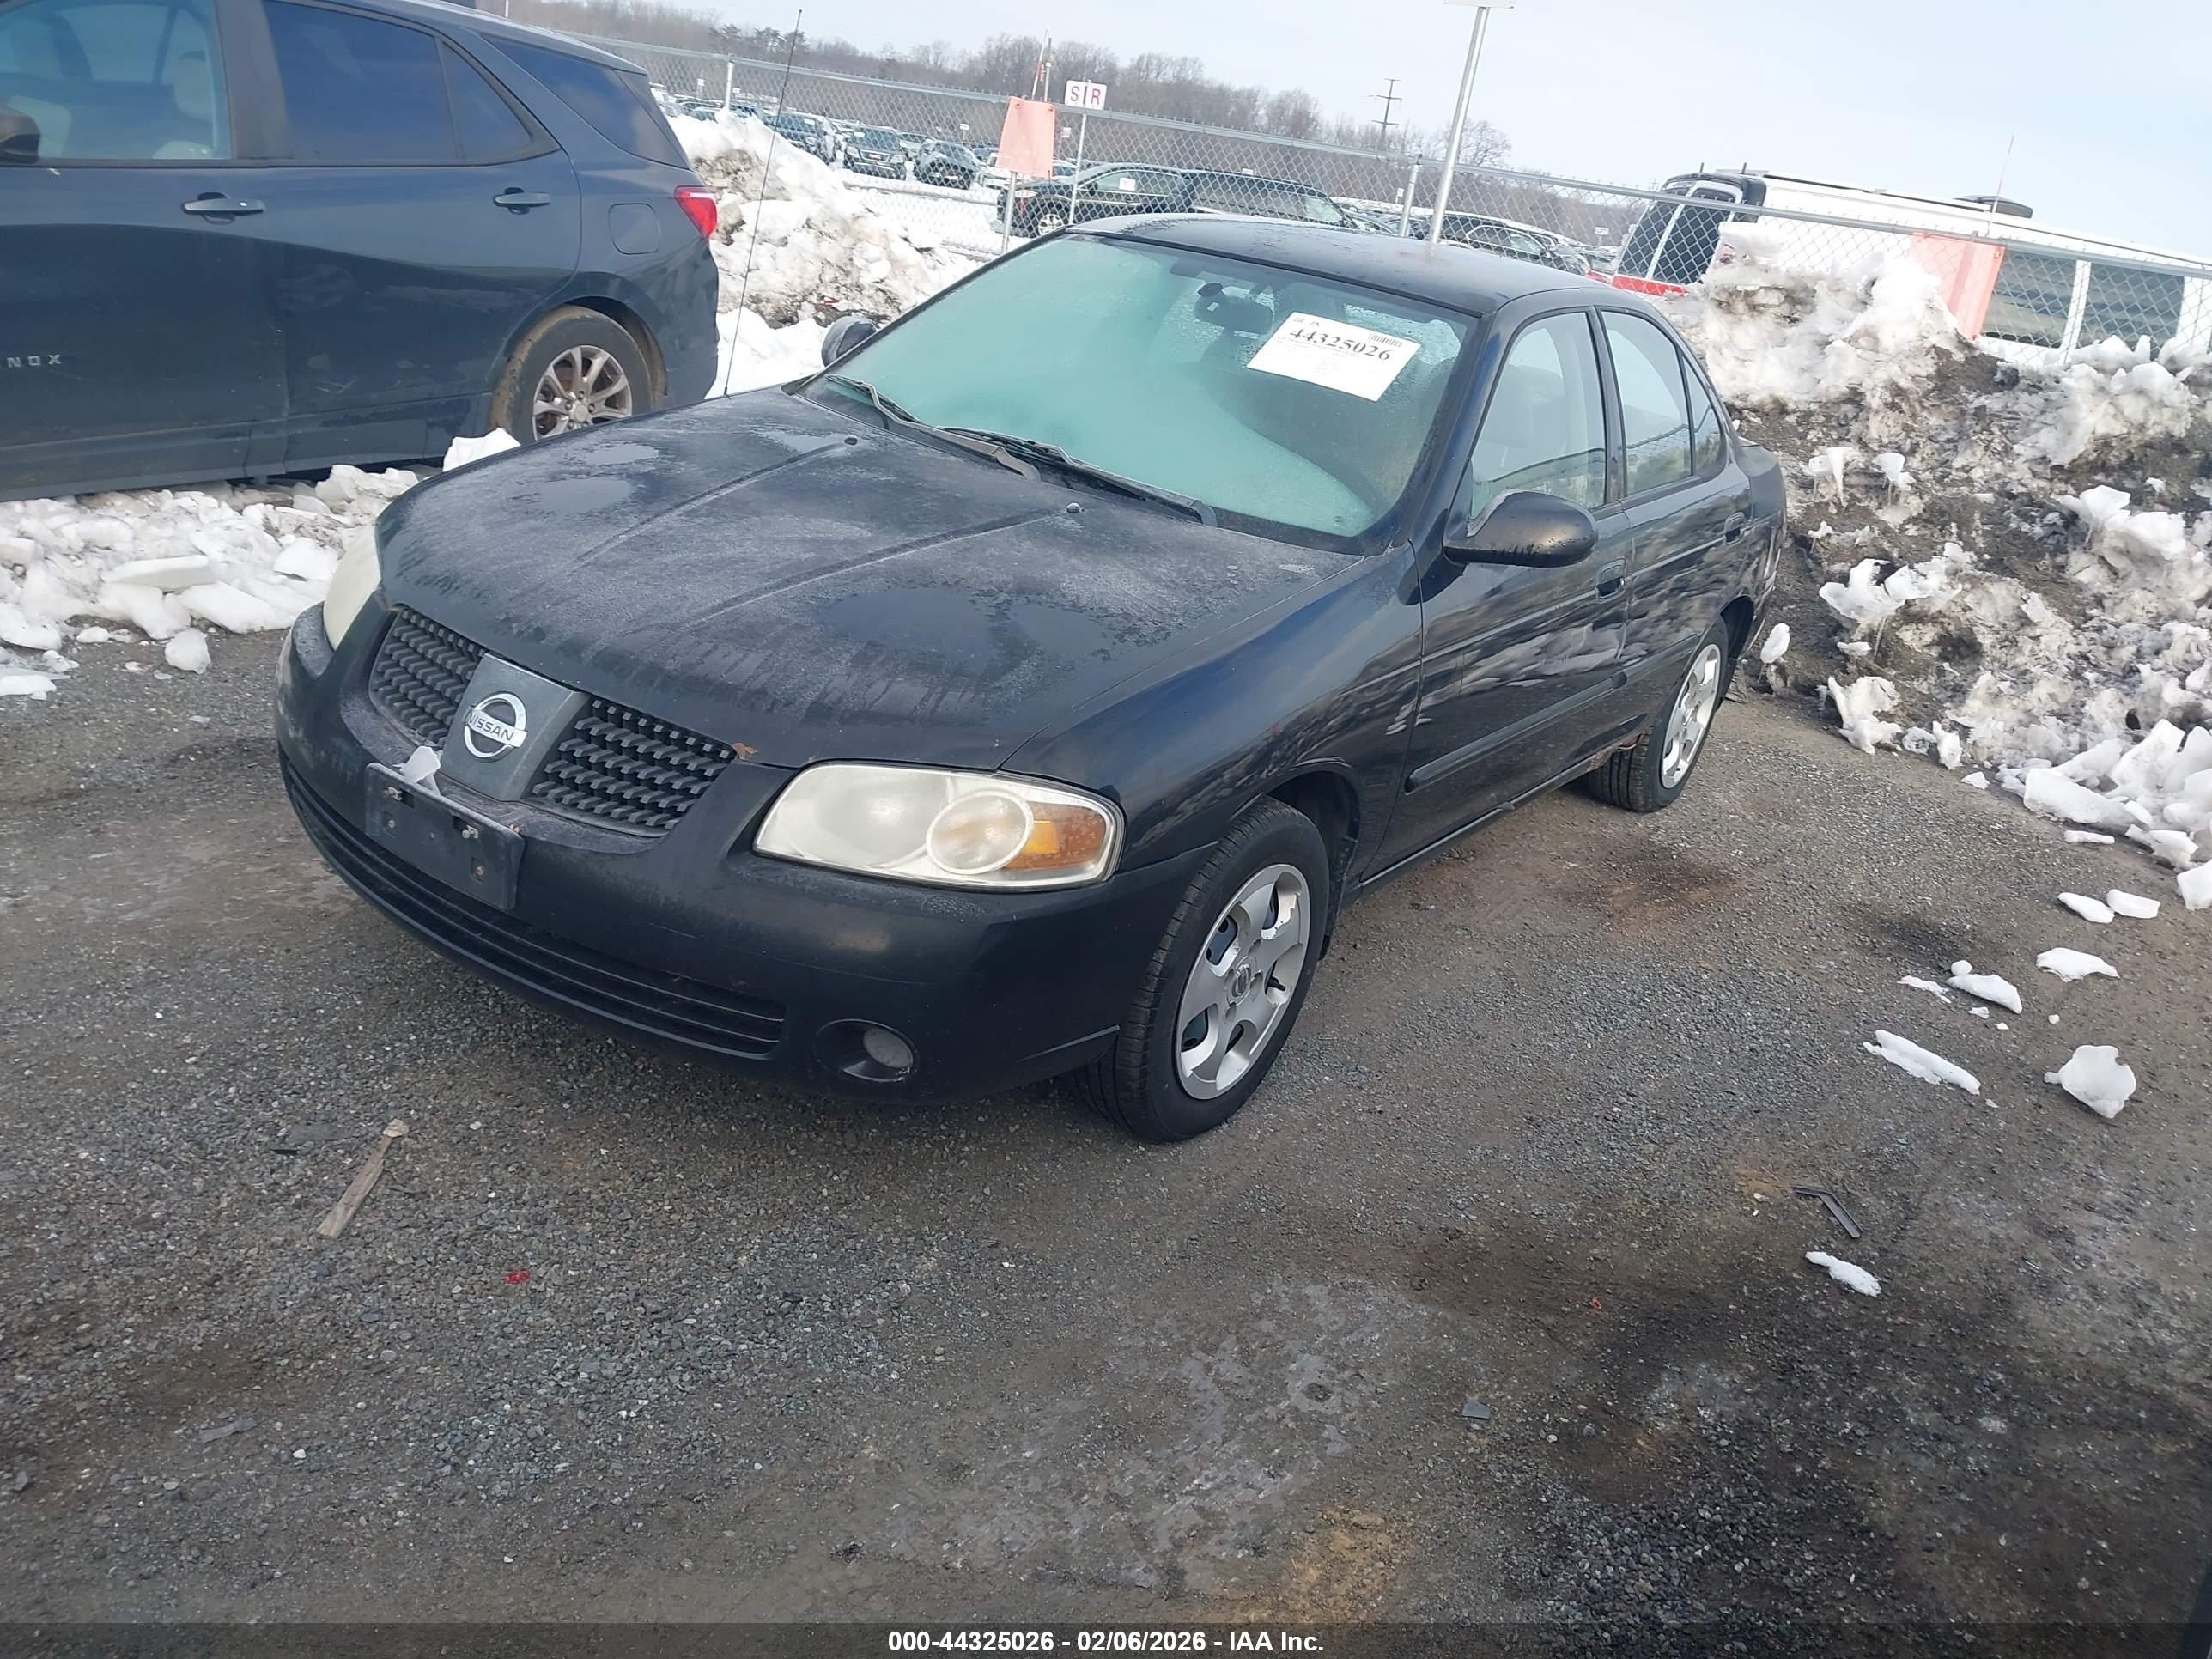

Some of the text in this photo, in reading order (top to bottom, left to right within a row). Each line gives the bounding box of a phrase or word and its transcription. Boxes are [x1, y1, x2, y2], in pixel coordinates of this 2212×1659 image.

[1070, 85, 1101, 106] S R
[1290, 328, 1395, 361] 44325026
[465, 710, 515, 741] NISSAN
